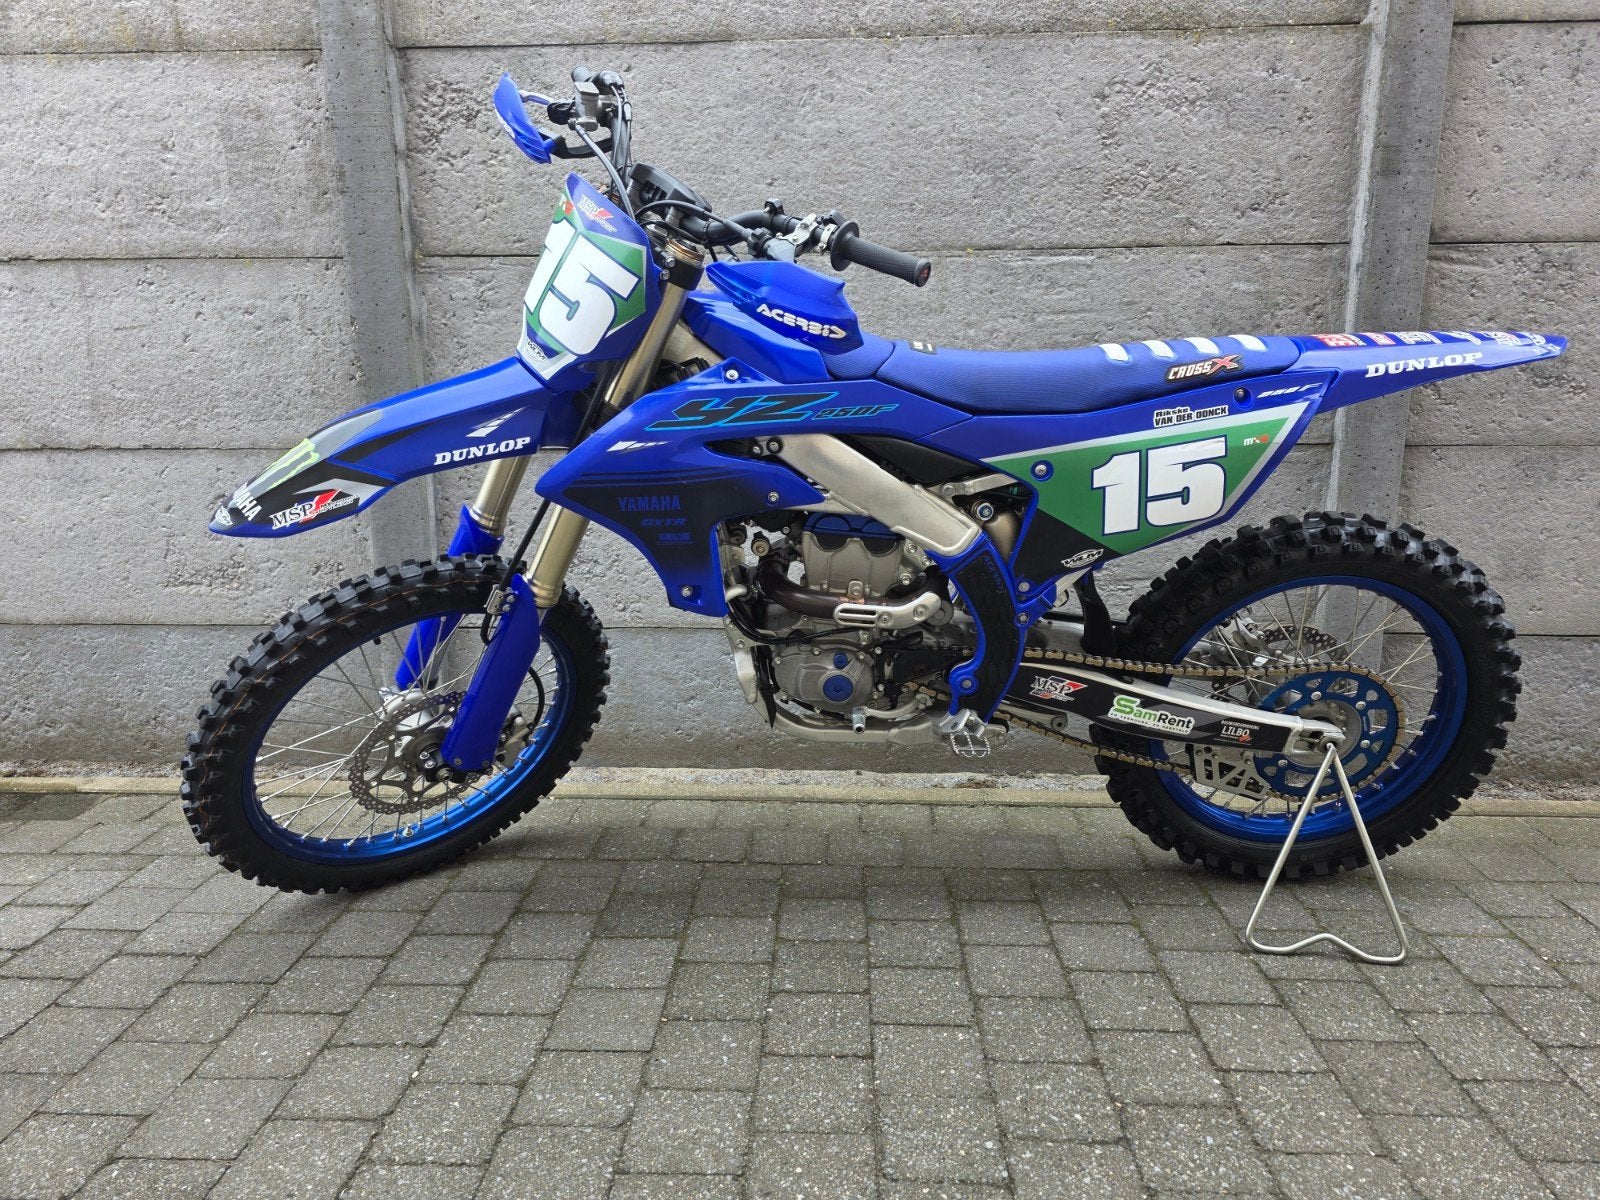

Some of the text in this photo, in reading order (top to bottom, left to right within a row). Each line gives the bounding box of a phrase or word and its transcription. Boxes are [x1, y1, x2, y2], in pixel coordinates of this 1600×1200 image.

[523, 219, 641, 356] 15
[1365, 351, 1483, 378] DUNLOP
[643, 391, 839, 431] YZ
[1155, 407, 1190, 418] Rikske
[1155, 406, 1227, 427] VAN DER DONCK
[433, 436, 531, 466] DUNLOP
[1091, 434, 1228, 537] 15
[270, 501, 315, 530] MSP
[617, 494, 681, 513] YAMAHA
[1113, 697, 1192, 729] SamRent
[1221, 725, 1250, 738] LILBO
